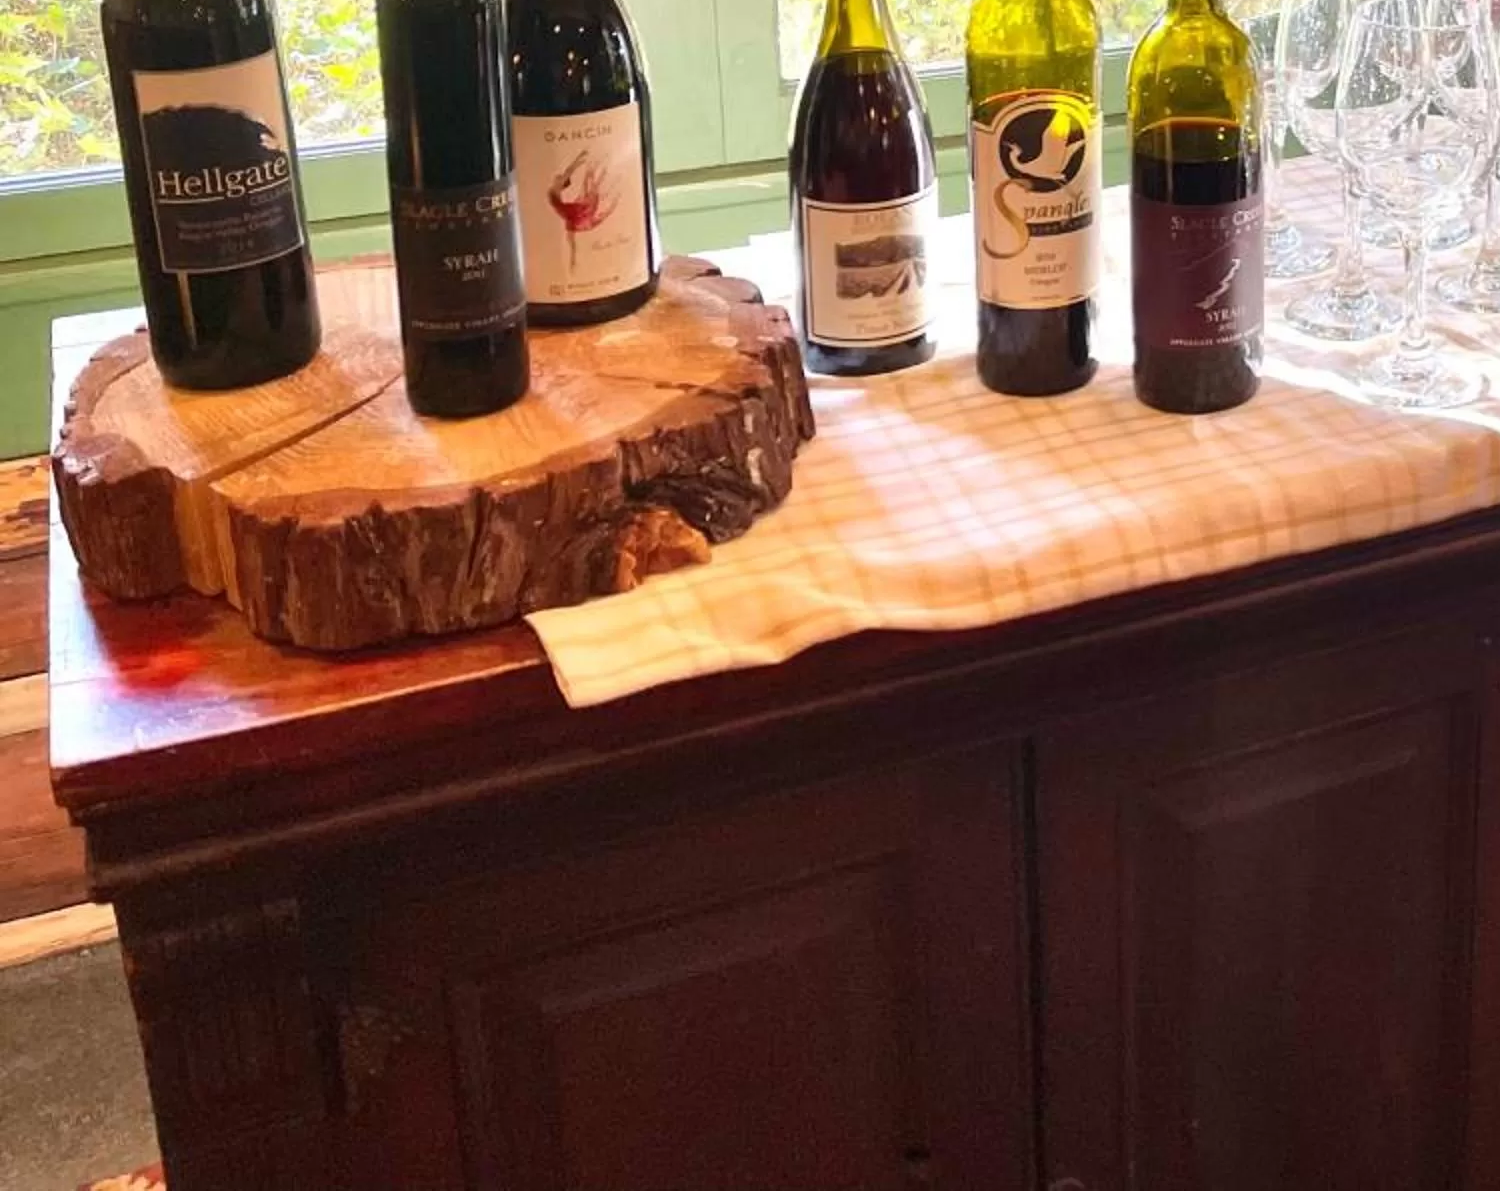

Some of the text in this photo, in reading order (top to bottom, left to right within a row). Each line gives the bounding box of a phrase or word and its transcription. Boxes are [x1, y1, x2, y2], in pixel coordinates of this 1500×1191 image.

[543, 124, 612, 143] DANCIN
[156, 155, 289, 198] Hellgate
[443, 248, 499, 271] SYRAH
